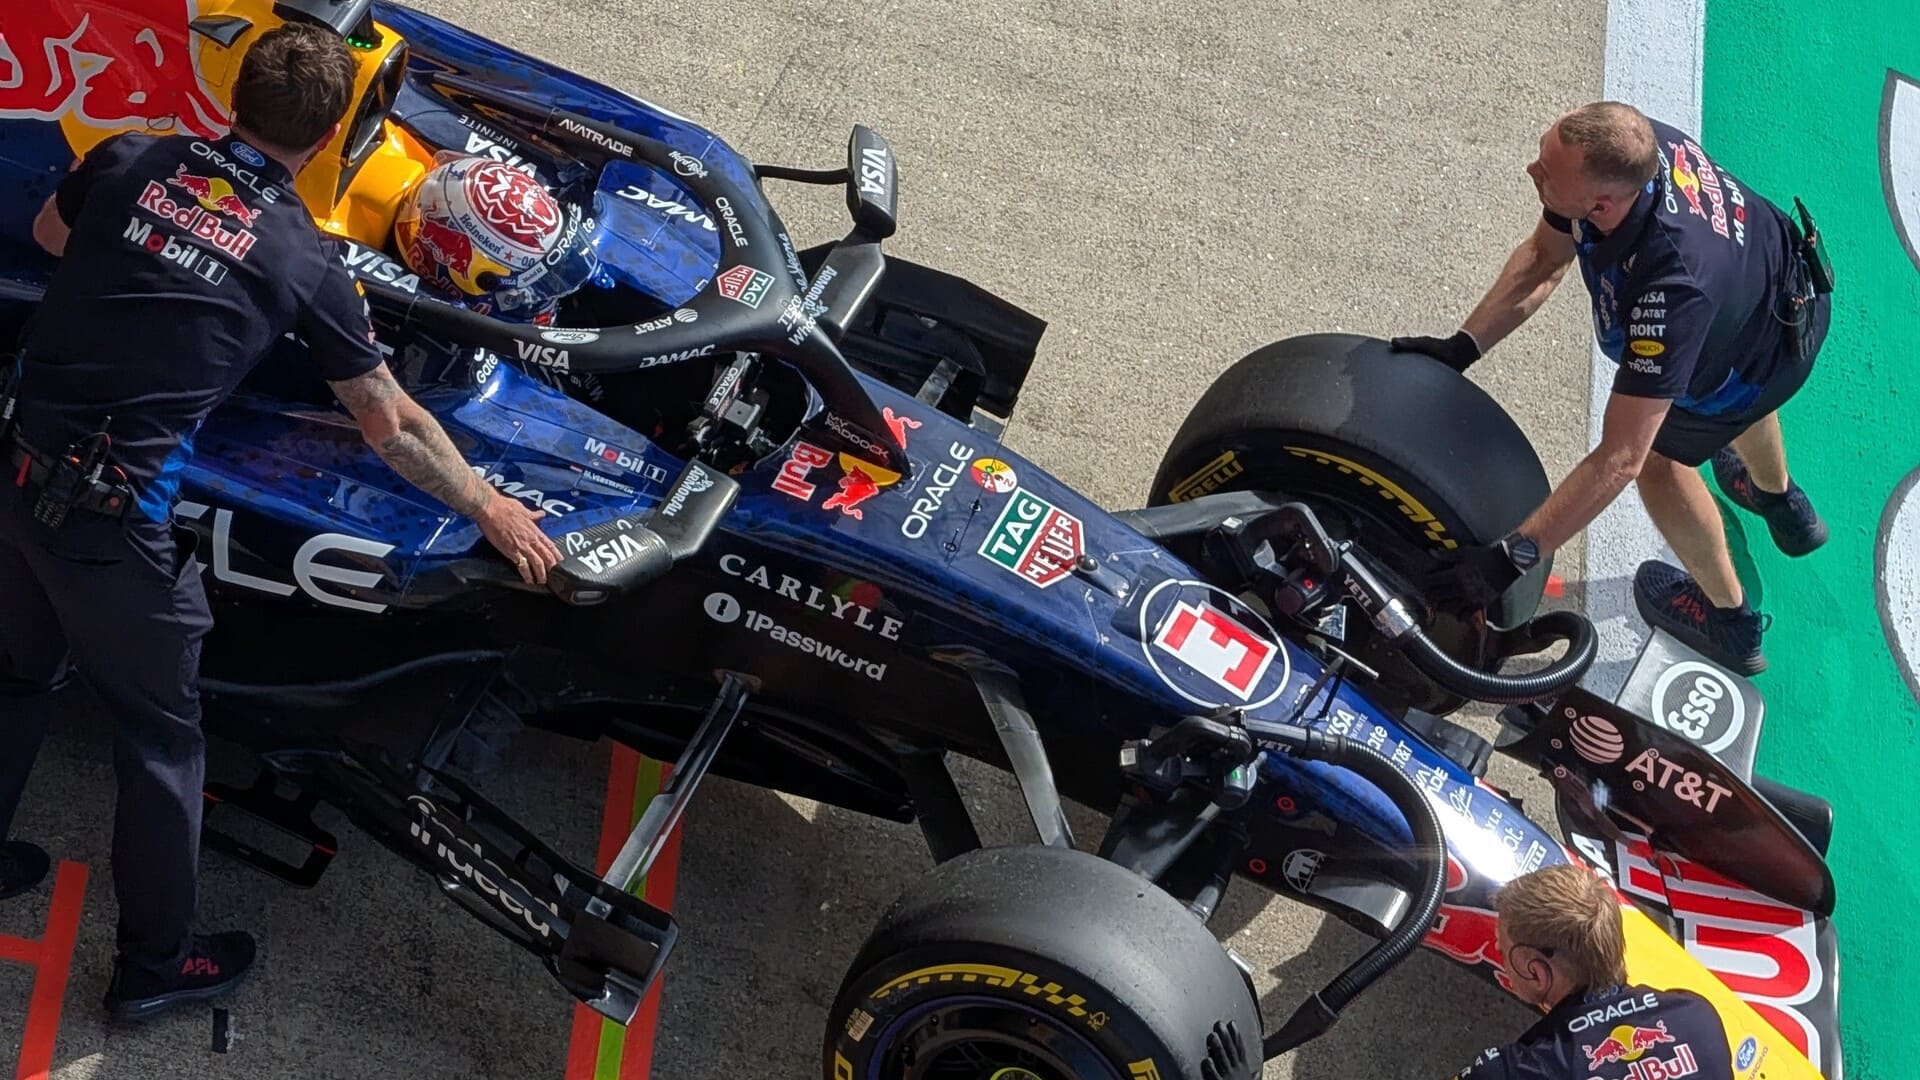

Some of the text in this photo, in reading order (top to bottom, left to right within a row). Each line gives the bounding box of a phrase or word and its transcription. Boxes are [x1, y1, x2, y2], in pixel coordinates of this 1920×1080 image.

[457, 113, 518, 149] INFINITE
[558, 118, 634, 157] AVATRADE
[190, 141, 281, 204] ORACLE
[233, 144, 261, 165] Ford
[861, 148, 887, 195] VISA
[1658, 146, 1678, 214] ORAC
[459, 213, 503, 254] Heineken
[715, 197, 748, 247] ORACLE
[123, 216, 199, 269] Mobil
[344, 240, 420, 294] VISA
[724, 267, 750, 297] HEUER
[743, 275, 769, 303] TAG
[634, 315, 673, 335] AT&T
[778, 294, 802, 326] TESCO
[1642, 309, 1667, 319] AT&T
[1630, 324, 1667, 337] ROKT
[476, 353, 498, 384] Gate
[513, 338, 570, 371] VISA
[639, 344, 716, 368] DAMAC
[709, 367, 739, 406] ORACLE
[584, 437, 645, 474] Mobil
[474, 466, 576, 518] MAC
[662, 465, 706, 517] ARMORALL
[901, 441, 974, 540] ORACLE
[990, 498, 1043, 556] TAG
[577, 534, 649, 574] VISA
[1025, 515, 1075, 580] HEUER
[719, 553, 904, 641] CARLYLE
[1344, 573, 1373, 607] YETI
[745, 610, 888, 681] 1Password
[1154, 600, 1278, 701] 3
[1256, 738, 1295, 752] YETI
[1367, 725, 1389, 751] ate
[1392, 739, 1414, 769] T&T
[1624, 750, 1733, 814] AT&T
[1568, 992, 1659, 1033] ORACLE
